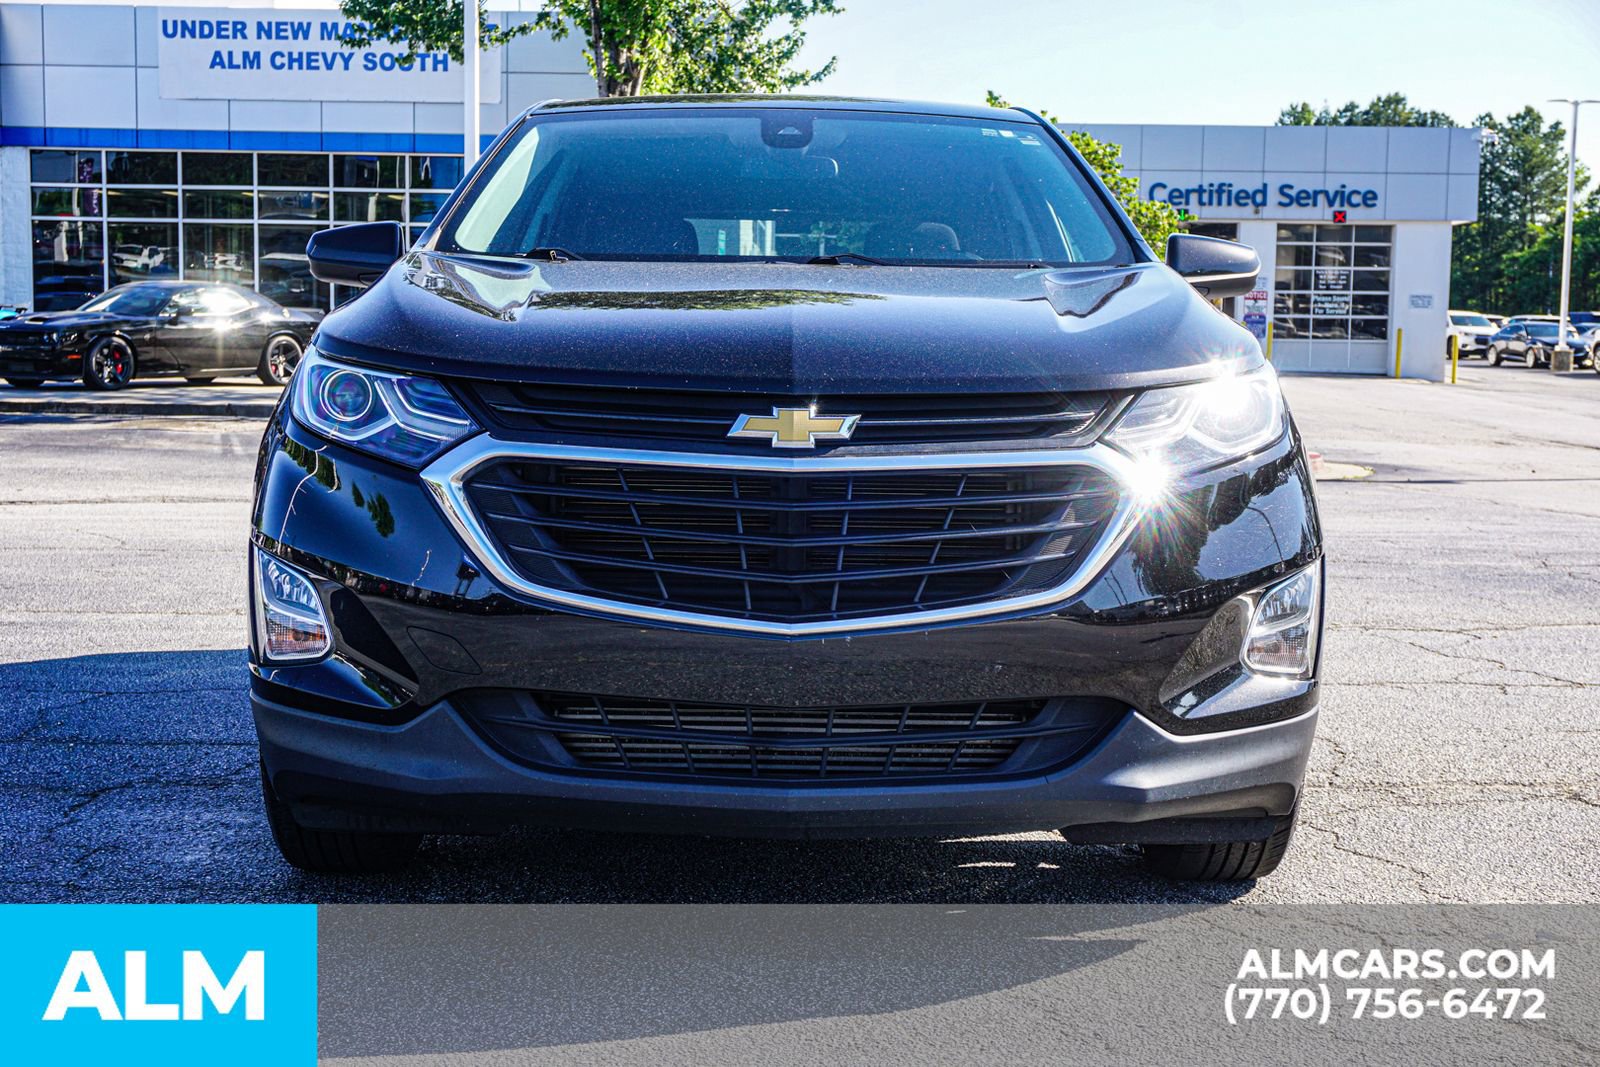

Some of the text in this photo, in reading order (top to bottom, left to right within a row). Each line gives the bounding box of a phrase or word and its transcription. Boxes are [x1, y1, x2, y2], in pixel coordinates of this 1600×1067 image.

[162, 19, 248, 40] UNDER
[256, 21, 312, 41] NEW
[209, 50, 261, 70] ALM
[270, 50, 354, 71] CHEVY
[1149, 182, 1379, 209] Certified Service
